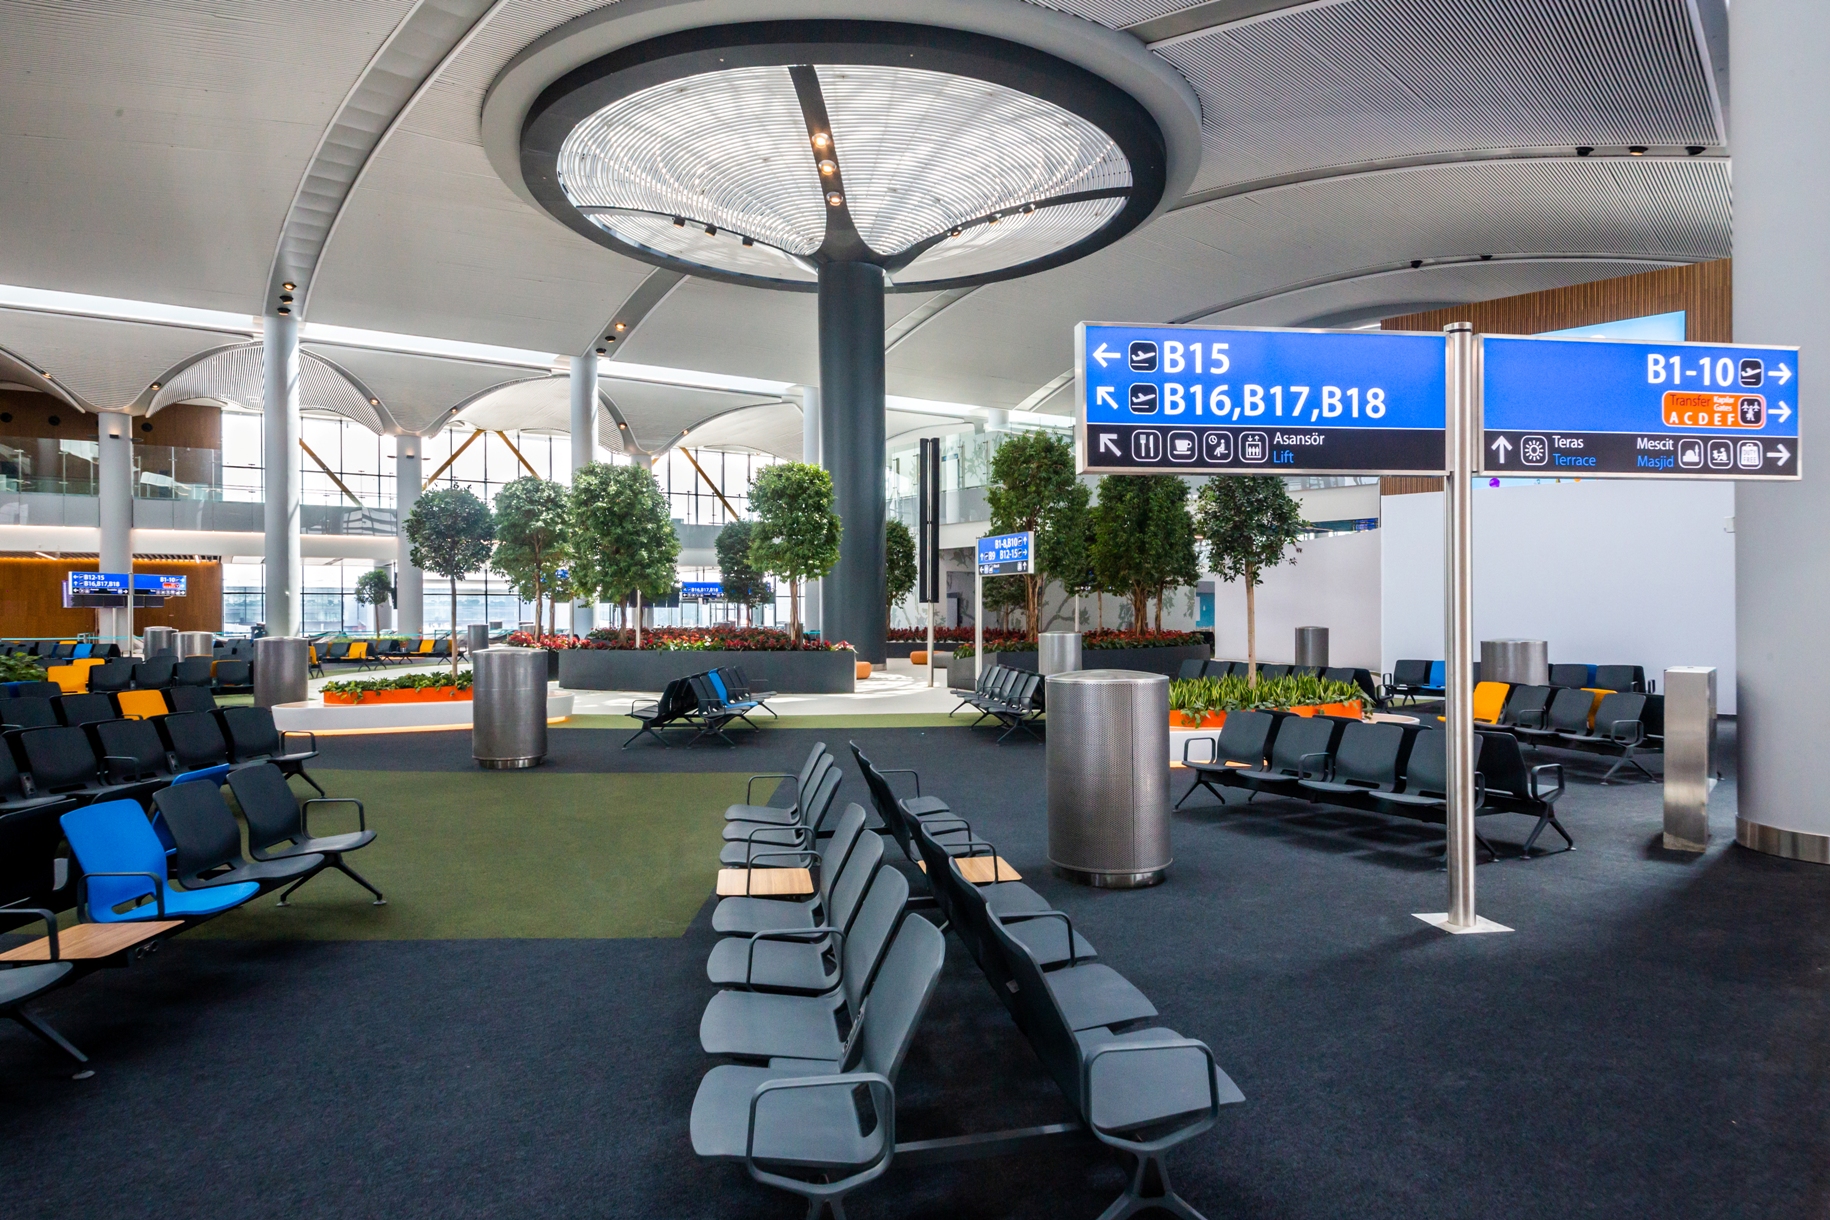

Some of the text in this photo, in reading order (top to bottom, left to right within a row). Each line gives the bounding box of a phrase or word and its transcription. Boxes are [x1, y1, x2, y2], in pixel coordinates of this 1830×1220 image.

[1163, 340, 1230, 374] B15
[1647, 354, 1735, 387] B1-10
[1163, 383, 1387, 421] B16,B17,B18
[1670, 394, 1711, 407] Transfer
[1713, 404, 1733, 412] Gates
[1669, 411, 1735, 425] A C D E F
[1273, 431, 1325, 446] Asansör
[1553, 436, 1584, 449] Teras
[1637, 438, 1674, 451] Mescit
[1273, 450, 1294, 464] Lift
[1553, 454, 1597, 467] Terrace
[1637, 456, 1674, 470] Masjid
